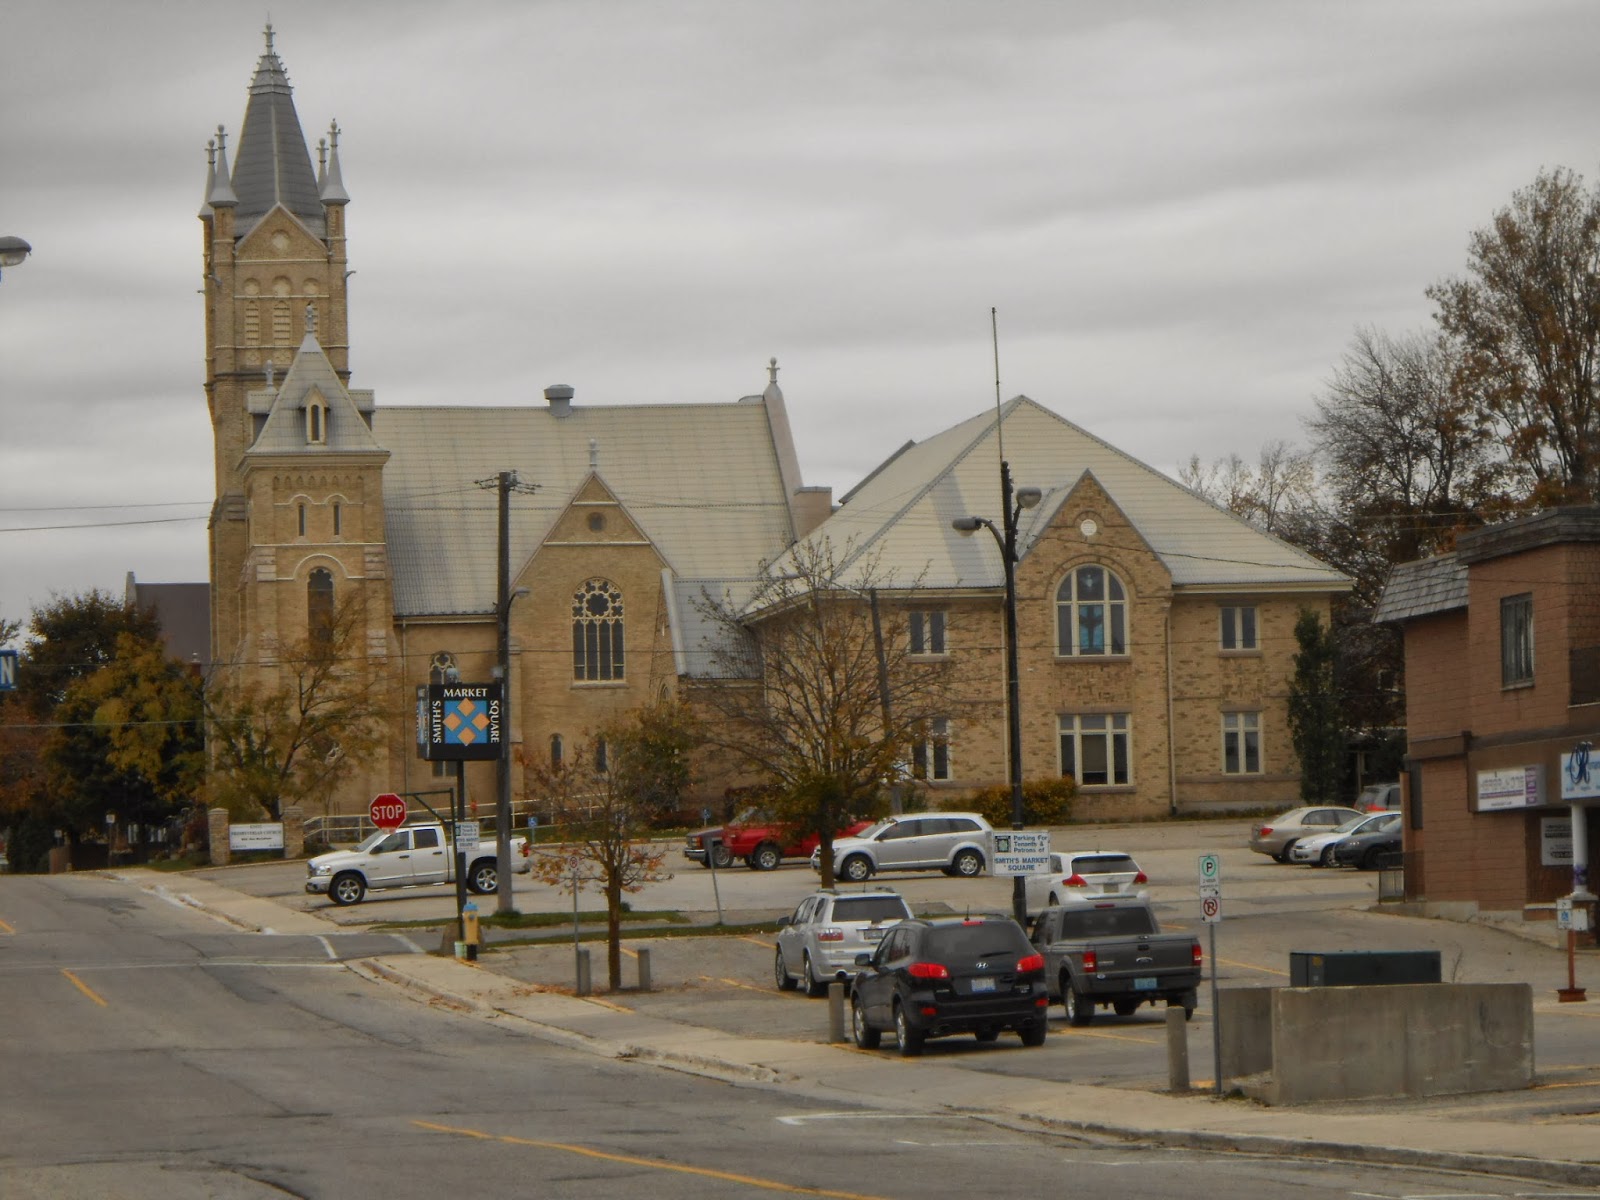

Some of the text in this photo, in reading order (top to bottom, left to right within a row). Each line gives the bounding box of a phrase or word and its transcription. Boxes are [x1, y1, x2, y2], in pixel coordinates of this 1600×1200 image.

[443, 688, 487, 697] MARKET
[432, 700, 441, 743] SMITH'S
[488, 700, 500, 743] SQUARE
[372, 805, 403, 820] STOP
[1206, 862, 1213, 873] P
